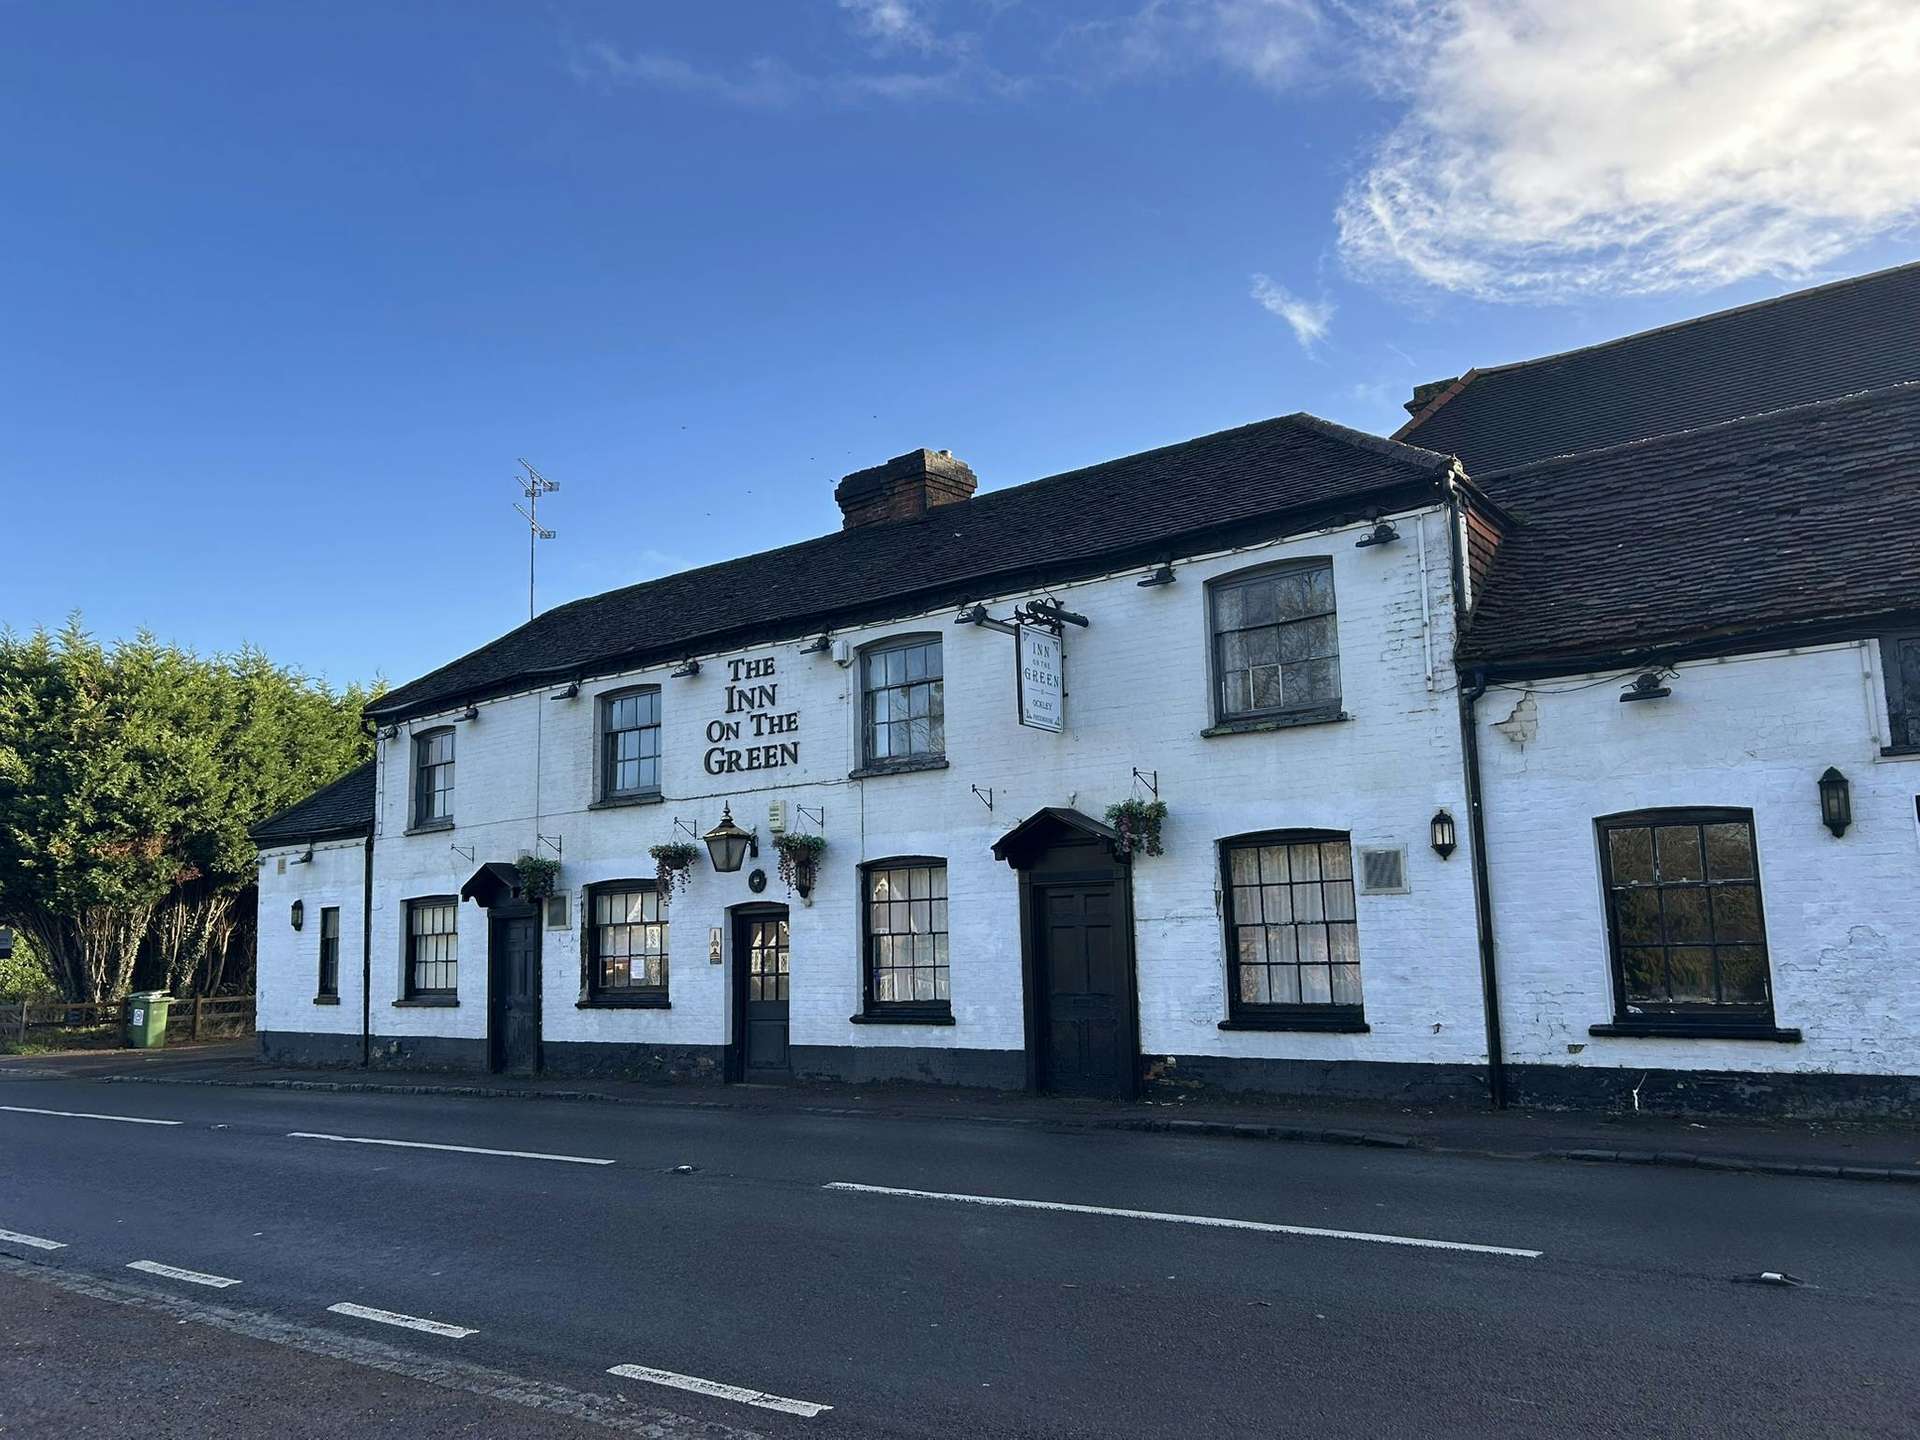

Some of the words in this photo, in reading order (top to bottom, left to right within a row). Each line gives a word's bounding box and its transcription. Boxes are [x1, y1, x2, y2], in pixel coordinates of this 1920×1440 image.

[1033, 642, 1050, 658] INN
[728, 657, 775, 682] THE
[1024, 667, 1060, 688] GREEN
[725, 684, 778, 713] INN
[706, 720, 741, 743] ON
[750, 713, 798, 737] THE
[704, 742, 800, 775] GREEN
